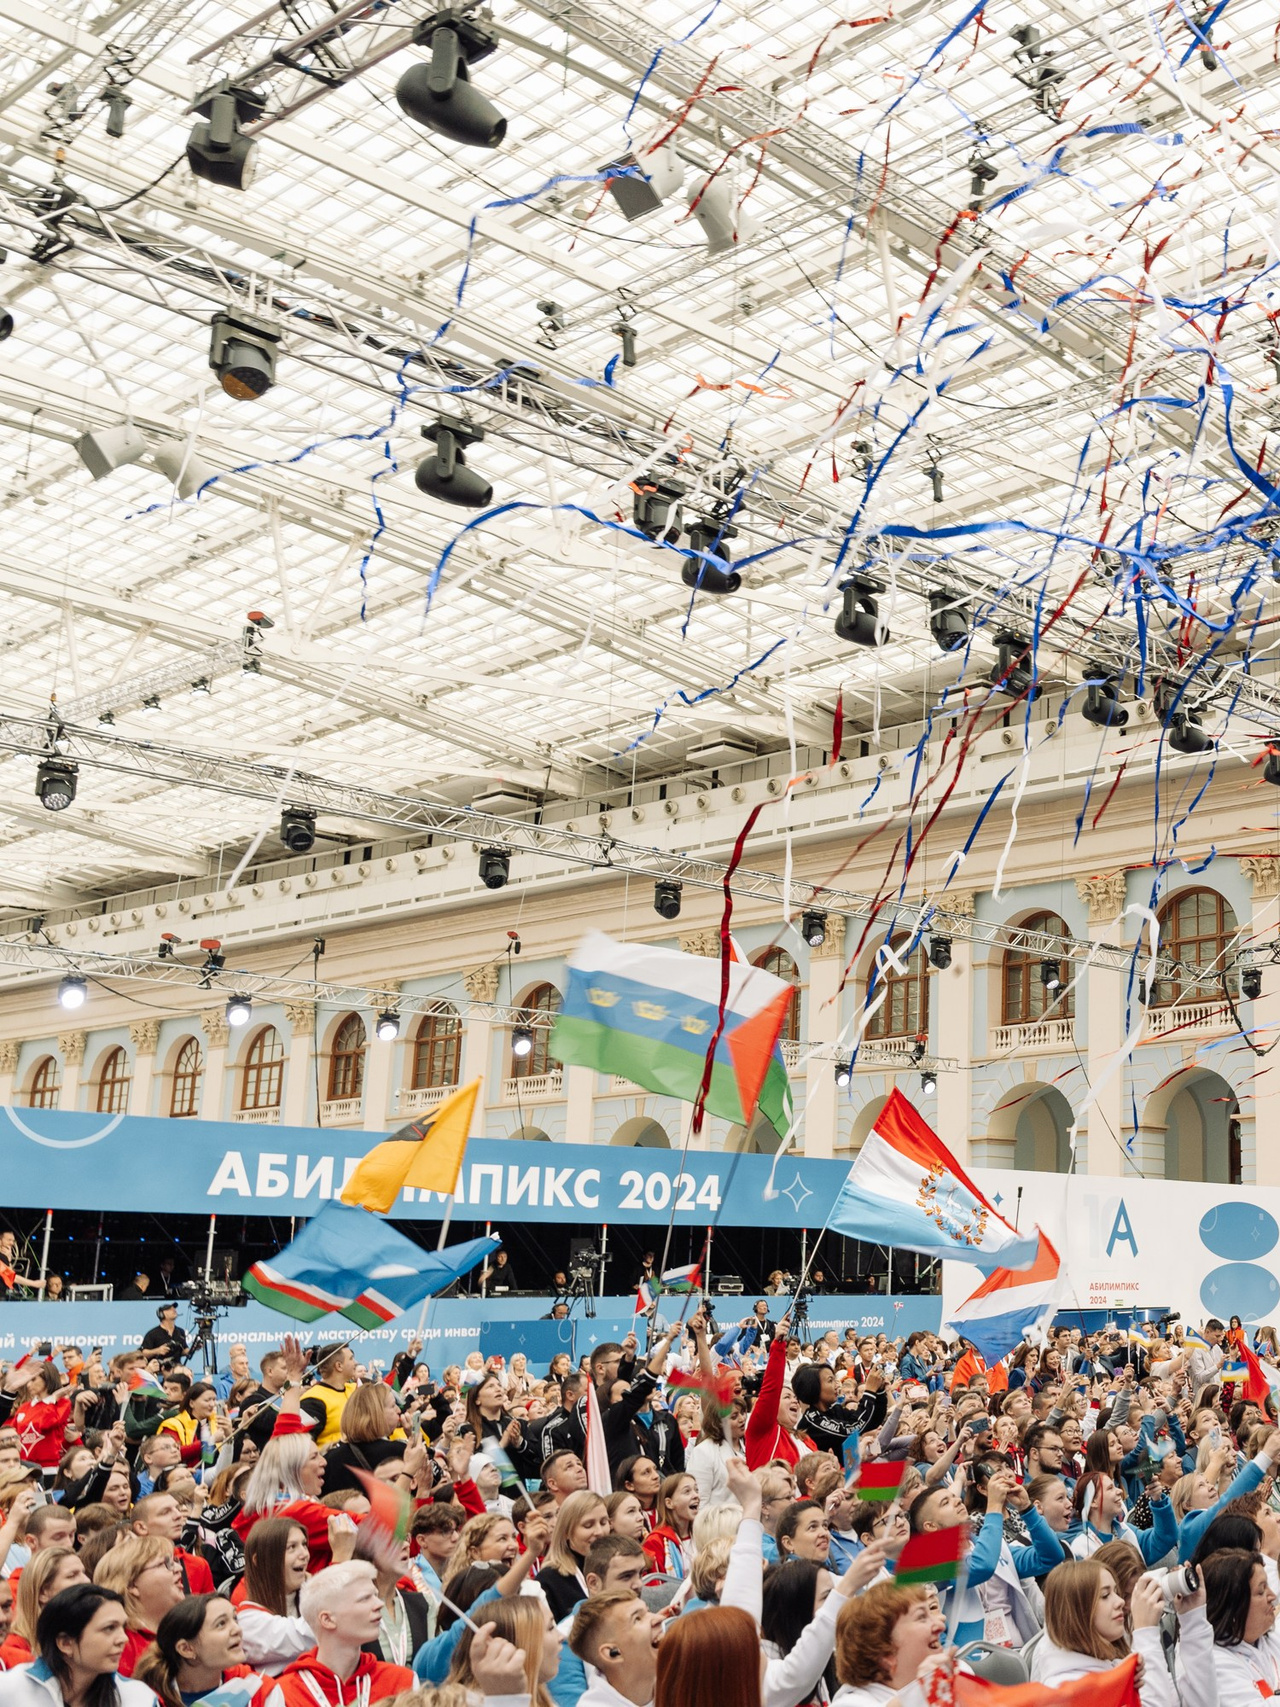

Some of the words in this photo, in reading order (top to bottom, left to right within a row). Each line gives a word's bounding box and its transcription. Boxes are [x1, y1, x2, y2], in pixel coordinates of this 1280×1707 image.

[617, 1170, 722, 1211] 2024
[1089, 1282, 1139, 1291] АБИЛИМПИКС
[1089, 1296, 1107, 1304] 2024
[861, 1316, 885, 1328] 2024
[317, 1328, 397, 1343] мастерству
